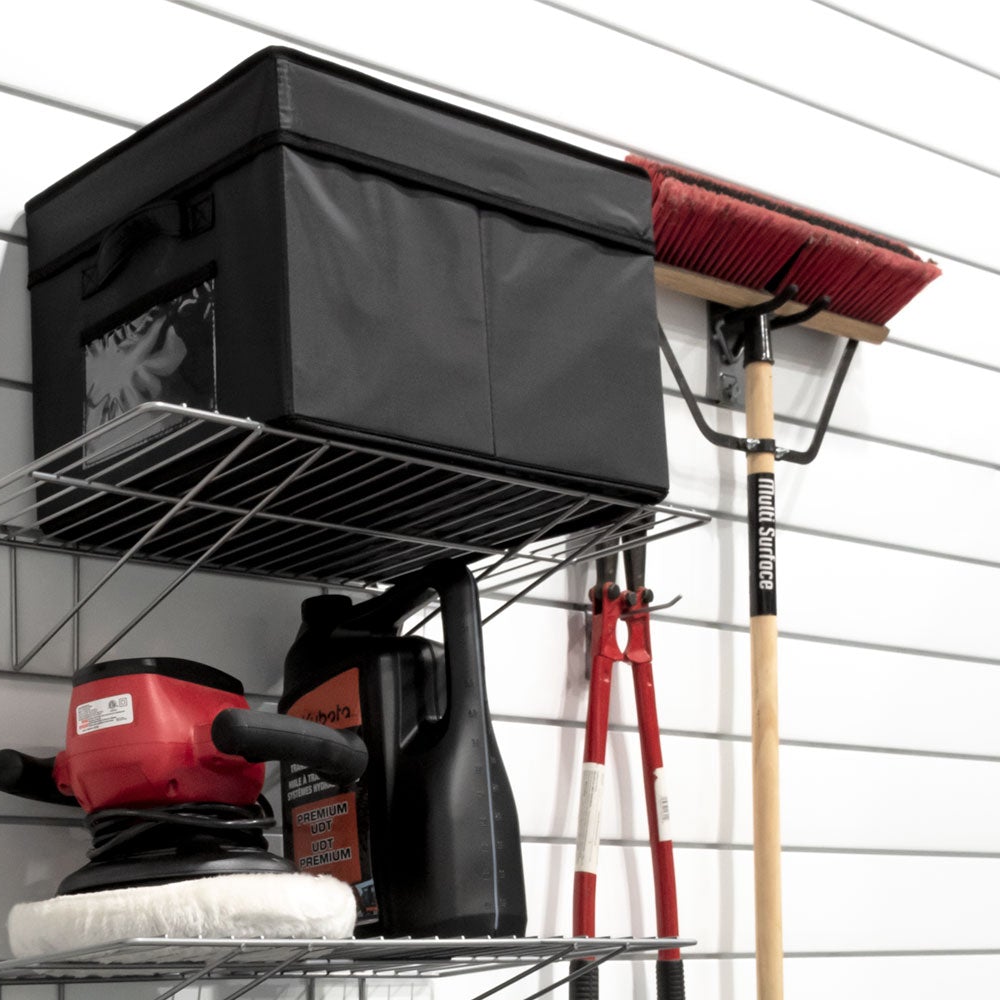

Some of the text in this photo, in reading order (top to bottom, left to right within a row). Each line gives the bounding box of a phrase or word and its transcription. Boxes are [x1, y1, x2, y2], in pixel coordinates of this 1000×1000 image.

[758, 478, 775, 590] Multi Surface
[296, 801, 349, 826] PREMIUM
[310, 819, 334, 836] UDT
[311, 837, 335, 853] UDT
[299, 847, 352, 870] PREMIUM
